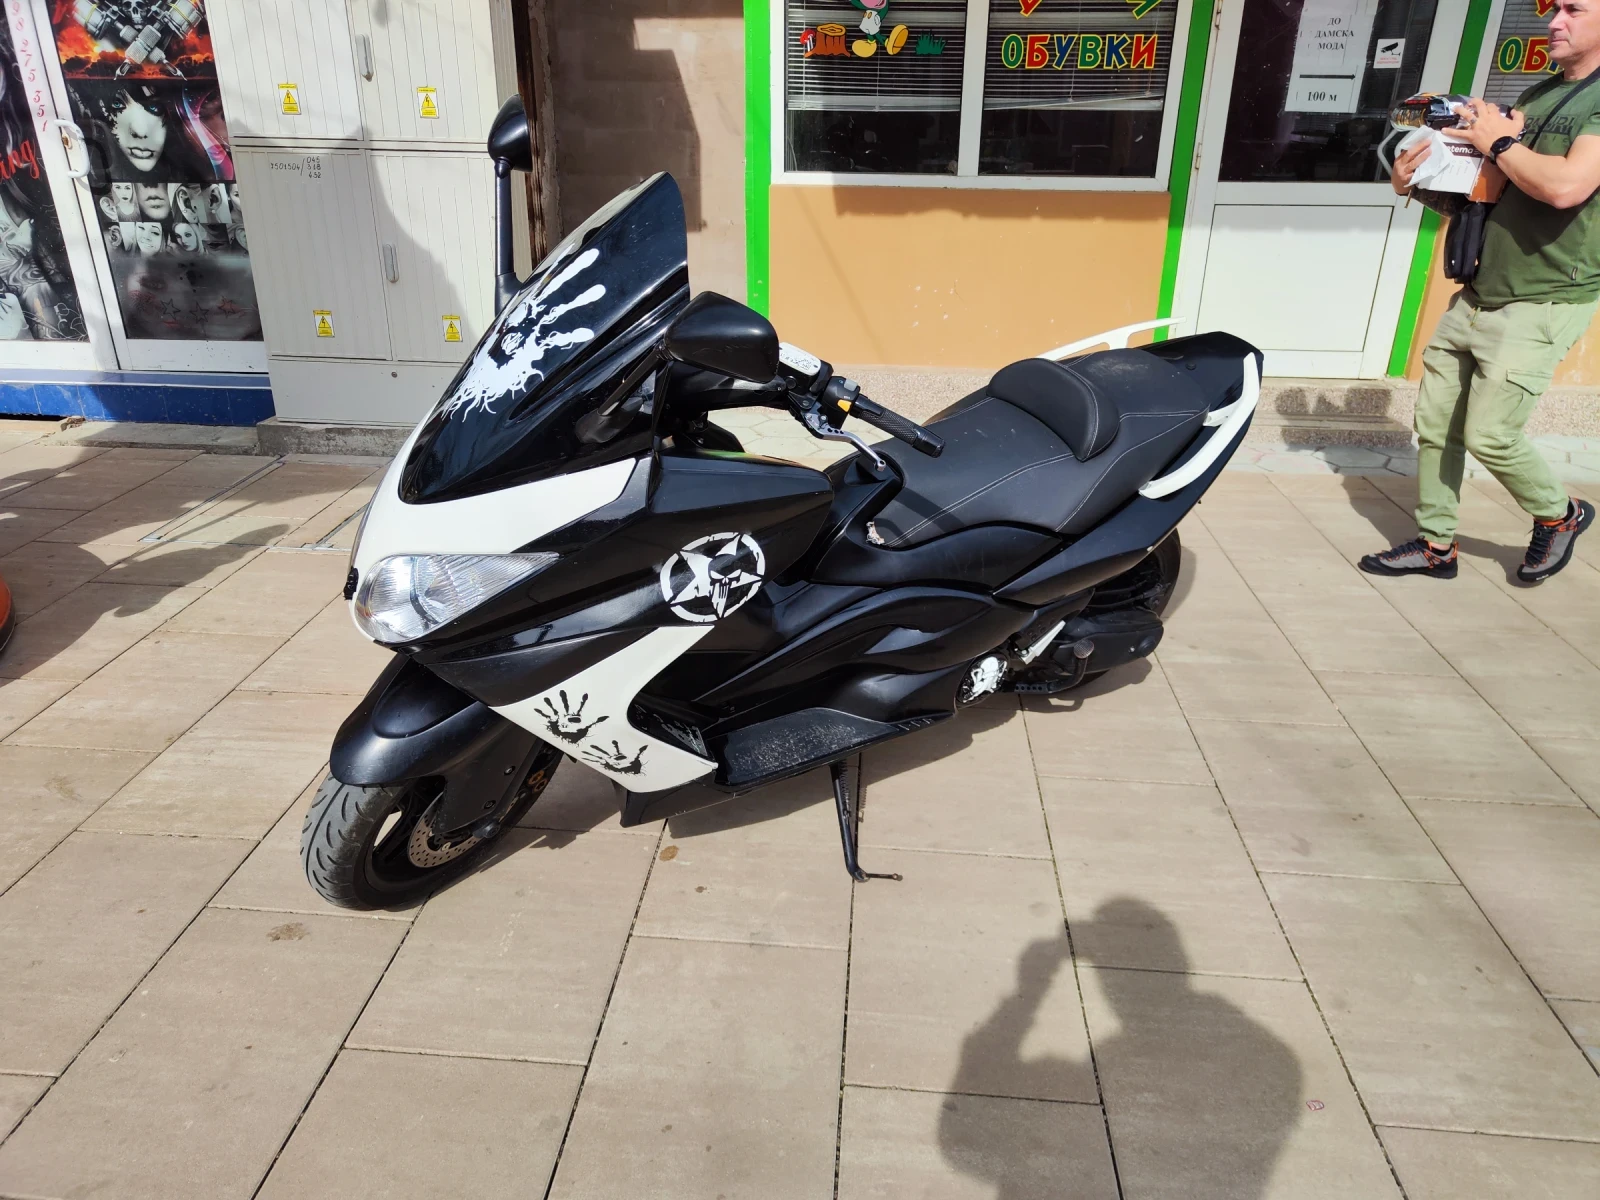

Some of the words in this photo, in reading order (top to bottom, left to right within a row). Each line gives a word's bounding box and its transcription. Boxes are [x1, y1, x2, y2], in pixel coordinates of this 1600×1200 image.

[1327, 17, 1342, 26] ДО
[1314, 29, 1355, 39] ДАМСКА
[1317, 41, 1345, 51] МОДА
[1001, 33, 1158, 70] ОБУВКИ
[1307, 91, 1326, 102] 100
[33, 90, 48, 132] 351
